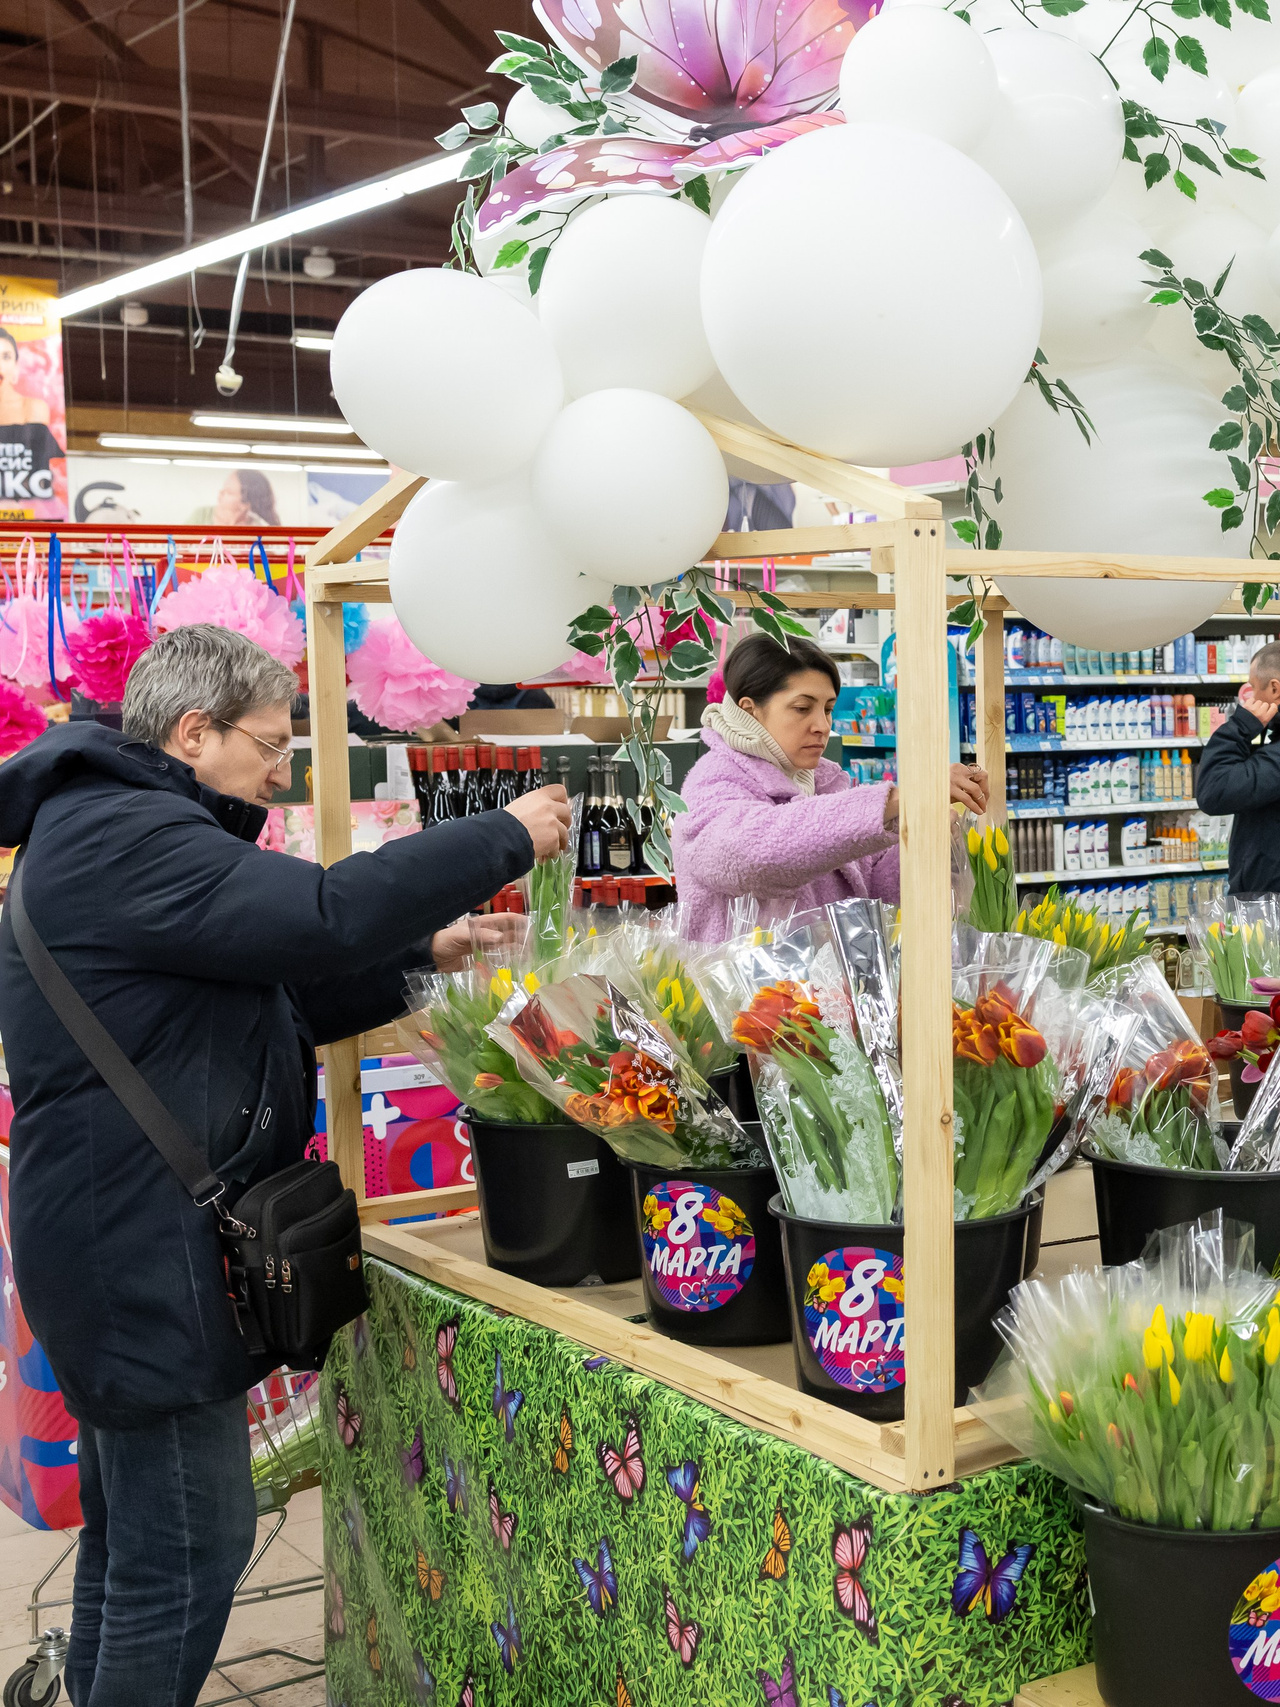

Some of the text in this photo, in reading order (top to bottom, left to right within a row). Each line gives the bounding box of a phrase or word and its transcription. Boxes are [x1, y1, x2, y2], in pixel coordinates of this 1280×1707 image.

[413, 1073, 425, 1081] 309
[667, 1191, 704, 1245] 8
[650, 1242, 743, 1278] МАРТА
[838, 1258, 888, 1318] 8
